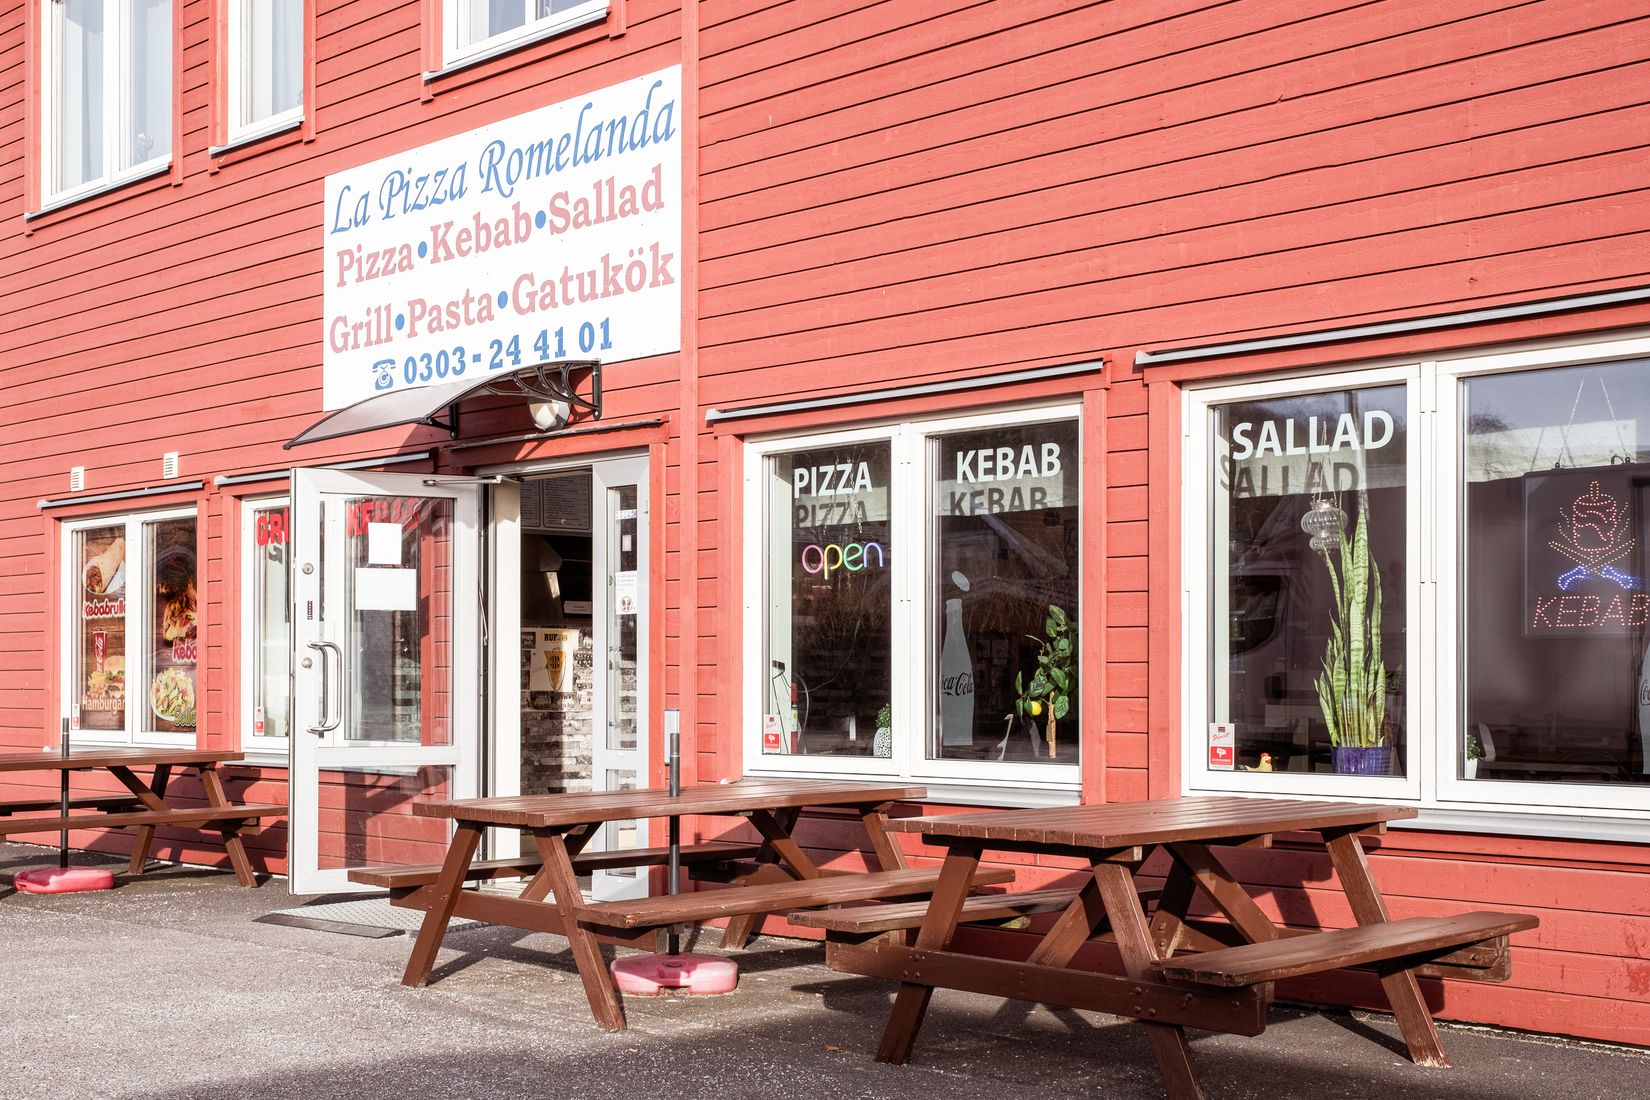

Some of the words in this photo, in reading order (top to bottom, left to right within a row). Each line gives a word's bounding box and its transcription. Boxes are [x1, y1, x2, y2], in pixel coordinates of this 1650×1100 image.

[330, 185, 370, 235] La
[379, 161, 468, 221] Pizza
[478, 79, 676, 199] Romelanda
[336, 243, 415, 288] Pizza
[429, 200, 532, 265] Kebab
[548, 162, 665, 236] Sallad
[329, 302, 394, 354] Grill
[406, 287, 495, 339] Pasta
[511, 240, 676, 316] Gatukök
[533, 326, 567, 361] 41
[578, 316, 613, 354] 01
[1231, 409, 1395, 461] SALLAD
[793, 461, 874, 499] PIZZA
[955, 441, 1062, 484] KEBAB
[801, 541, 885, 581] open
[1532, 593, 1650, 629] KEBAB
